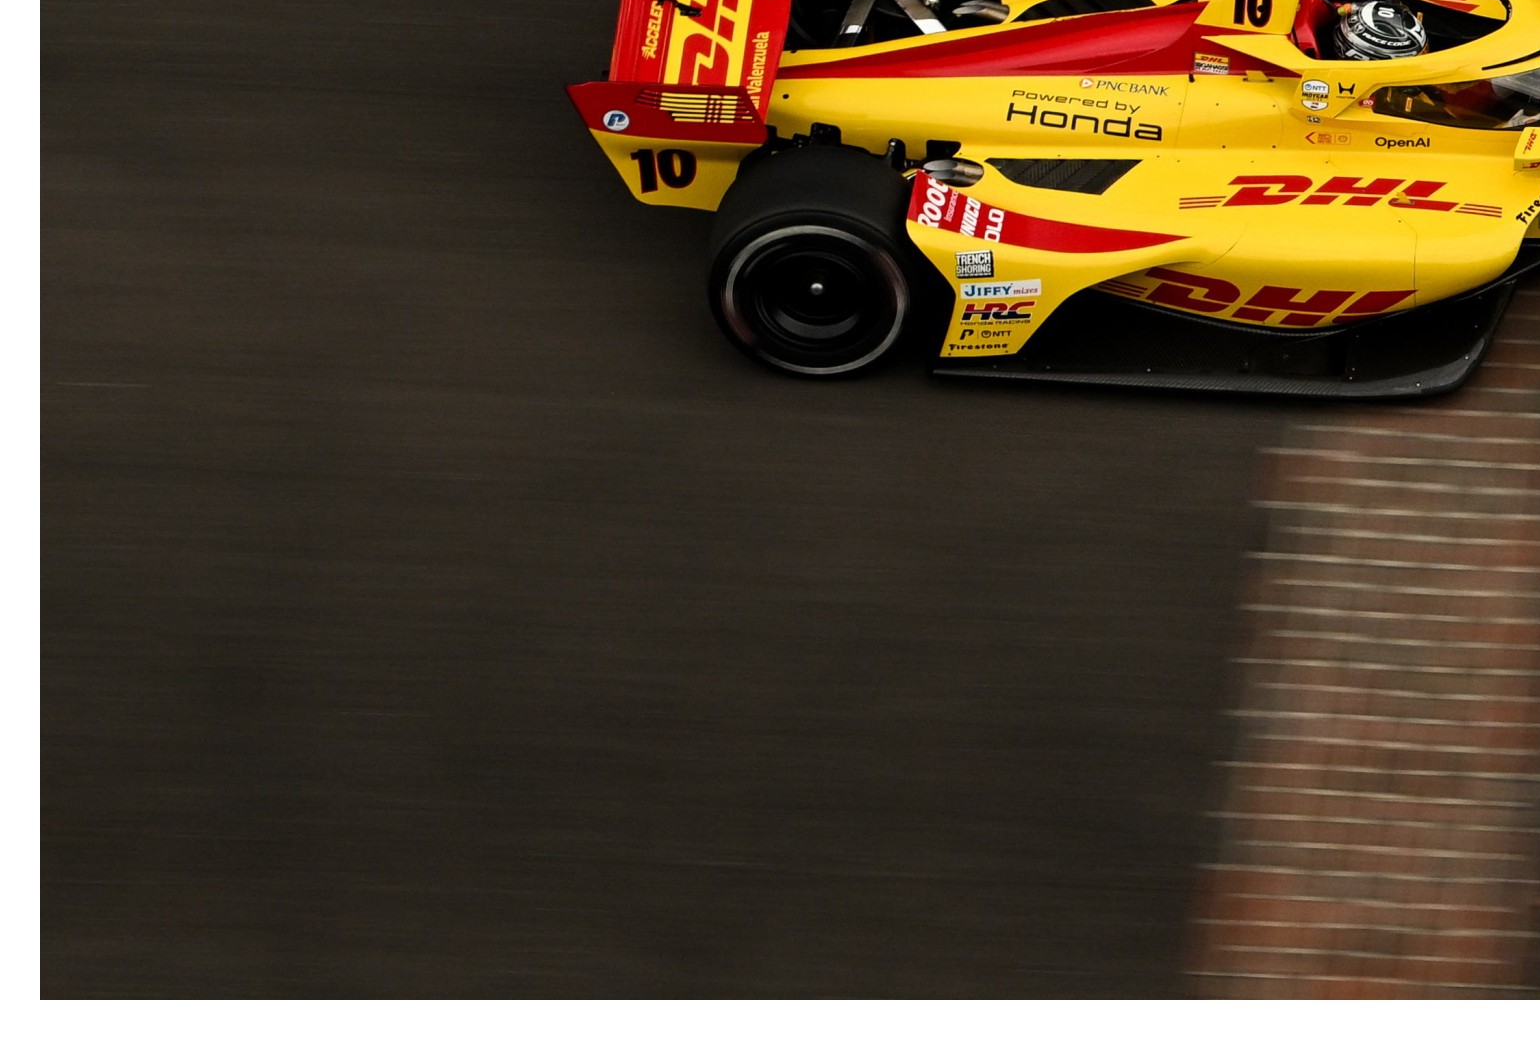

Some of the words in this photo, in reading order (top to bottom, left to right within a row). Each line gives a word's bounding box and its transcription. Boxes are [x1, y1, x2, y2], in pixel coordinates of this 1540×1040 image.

[1378, 7, 1395, 18] 10
[747, 31, 771, 95] Valenzuela
[1096, 79, 1128, 93] PNC
[1129, 82, 1171, 97] BANK
[1012, 89, 1109, 109] Powered
[1115, 100, 1141, 114] by
[1006, 103, 1163, 142] Honda
[1375, 137, 1430, 148] OpenAI
[630, 148, 697, 194] 10
[1221, 175, 1460, 212] DHL
[960, 196, 981, 237] NOCO
[984, 208, 1005, 243] OLO
[956, 253, 991, 265] TRENCH
[956, 264, 992, 274] SHORING
[964, 284, 1012, 297] JIFFY
[1145, 266, 1418, 327] DHL
[961, 301, 1036, 321] HRC
[949, 343, 1008, 351] Firestone
